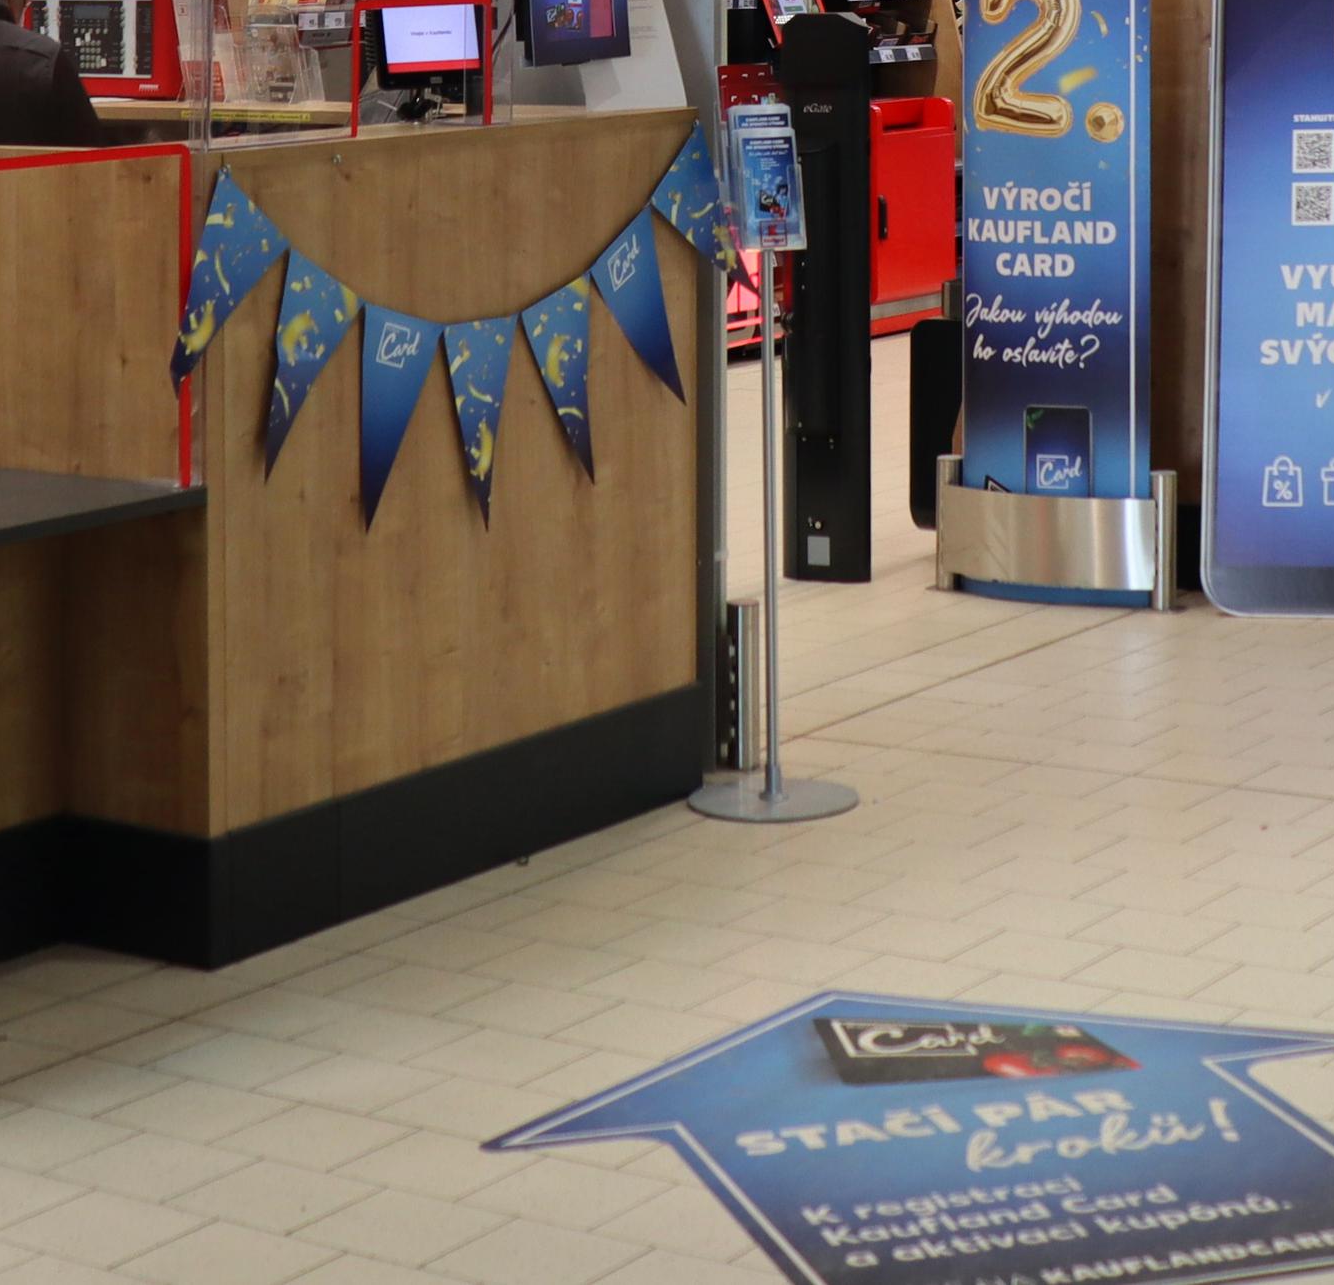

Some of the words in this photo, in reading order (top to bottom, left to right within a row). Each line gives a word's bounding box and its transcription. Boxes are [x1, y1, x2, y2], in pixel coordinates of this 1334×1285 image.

[982, 180, 1092, 212] VÝROČÍ
[967, 217, 1118, 245] KAUFLAND
[612, 233, 641, 287] Card
[995, 251, 1076, 278] CARD
[965, 292, 1027, 328] Jakou
[1034, 297, 1123, 339] výhodou
[379, 330, 421, 360] Card
[972, 333, 997, 361] ho
[1315, 388, 1333, 409] v
[1040, 454, 1083, 487] Card
[857, 1023, 1006, 1055] Card
[972, 1088, 1135, 1128] PÁR
[802, 1204, 842, 1226] K
[854, 1174, 1084, 1220] registraci
[821, 1201, 1052, 1247] Kaufland
[1061, 1184, 1179, 1214] Card
[845, 1251, 879, 1268] a
[892, 1220, 1090, 1263] aktivaci
